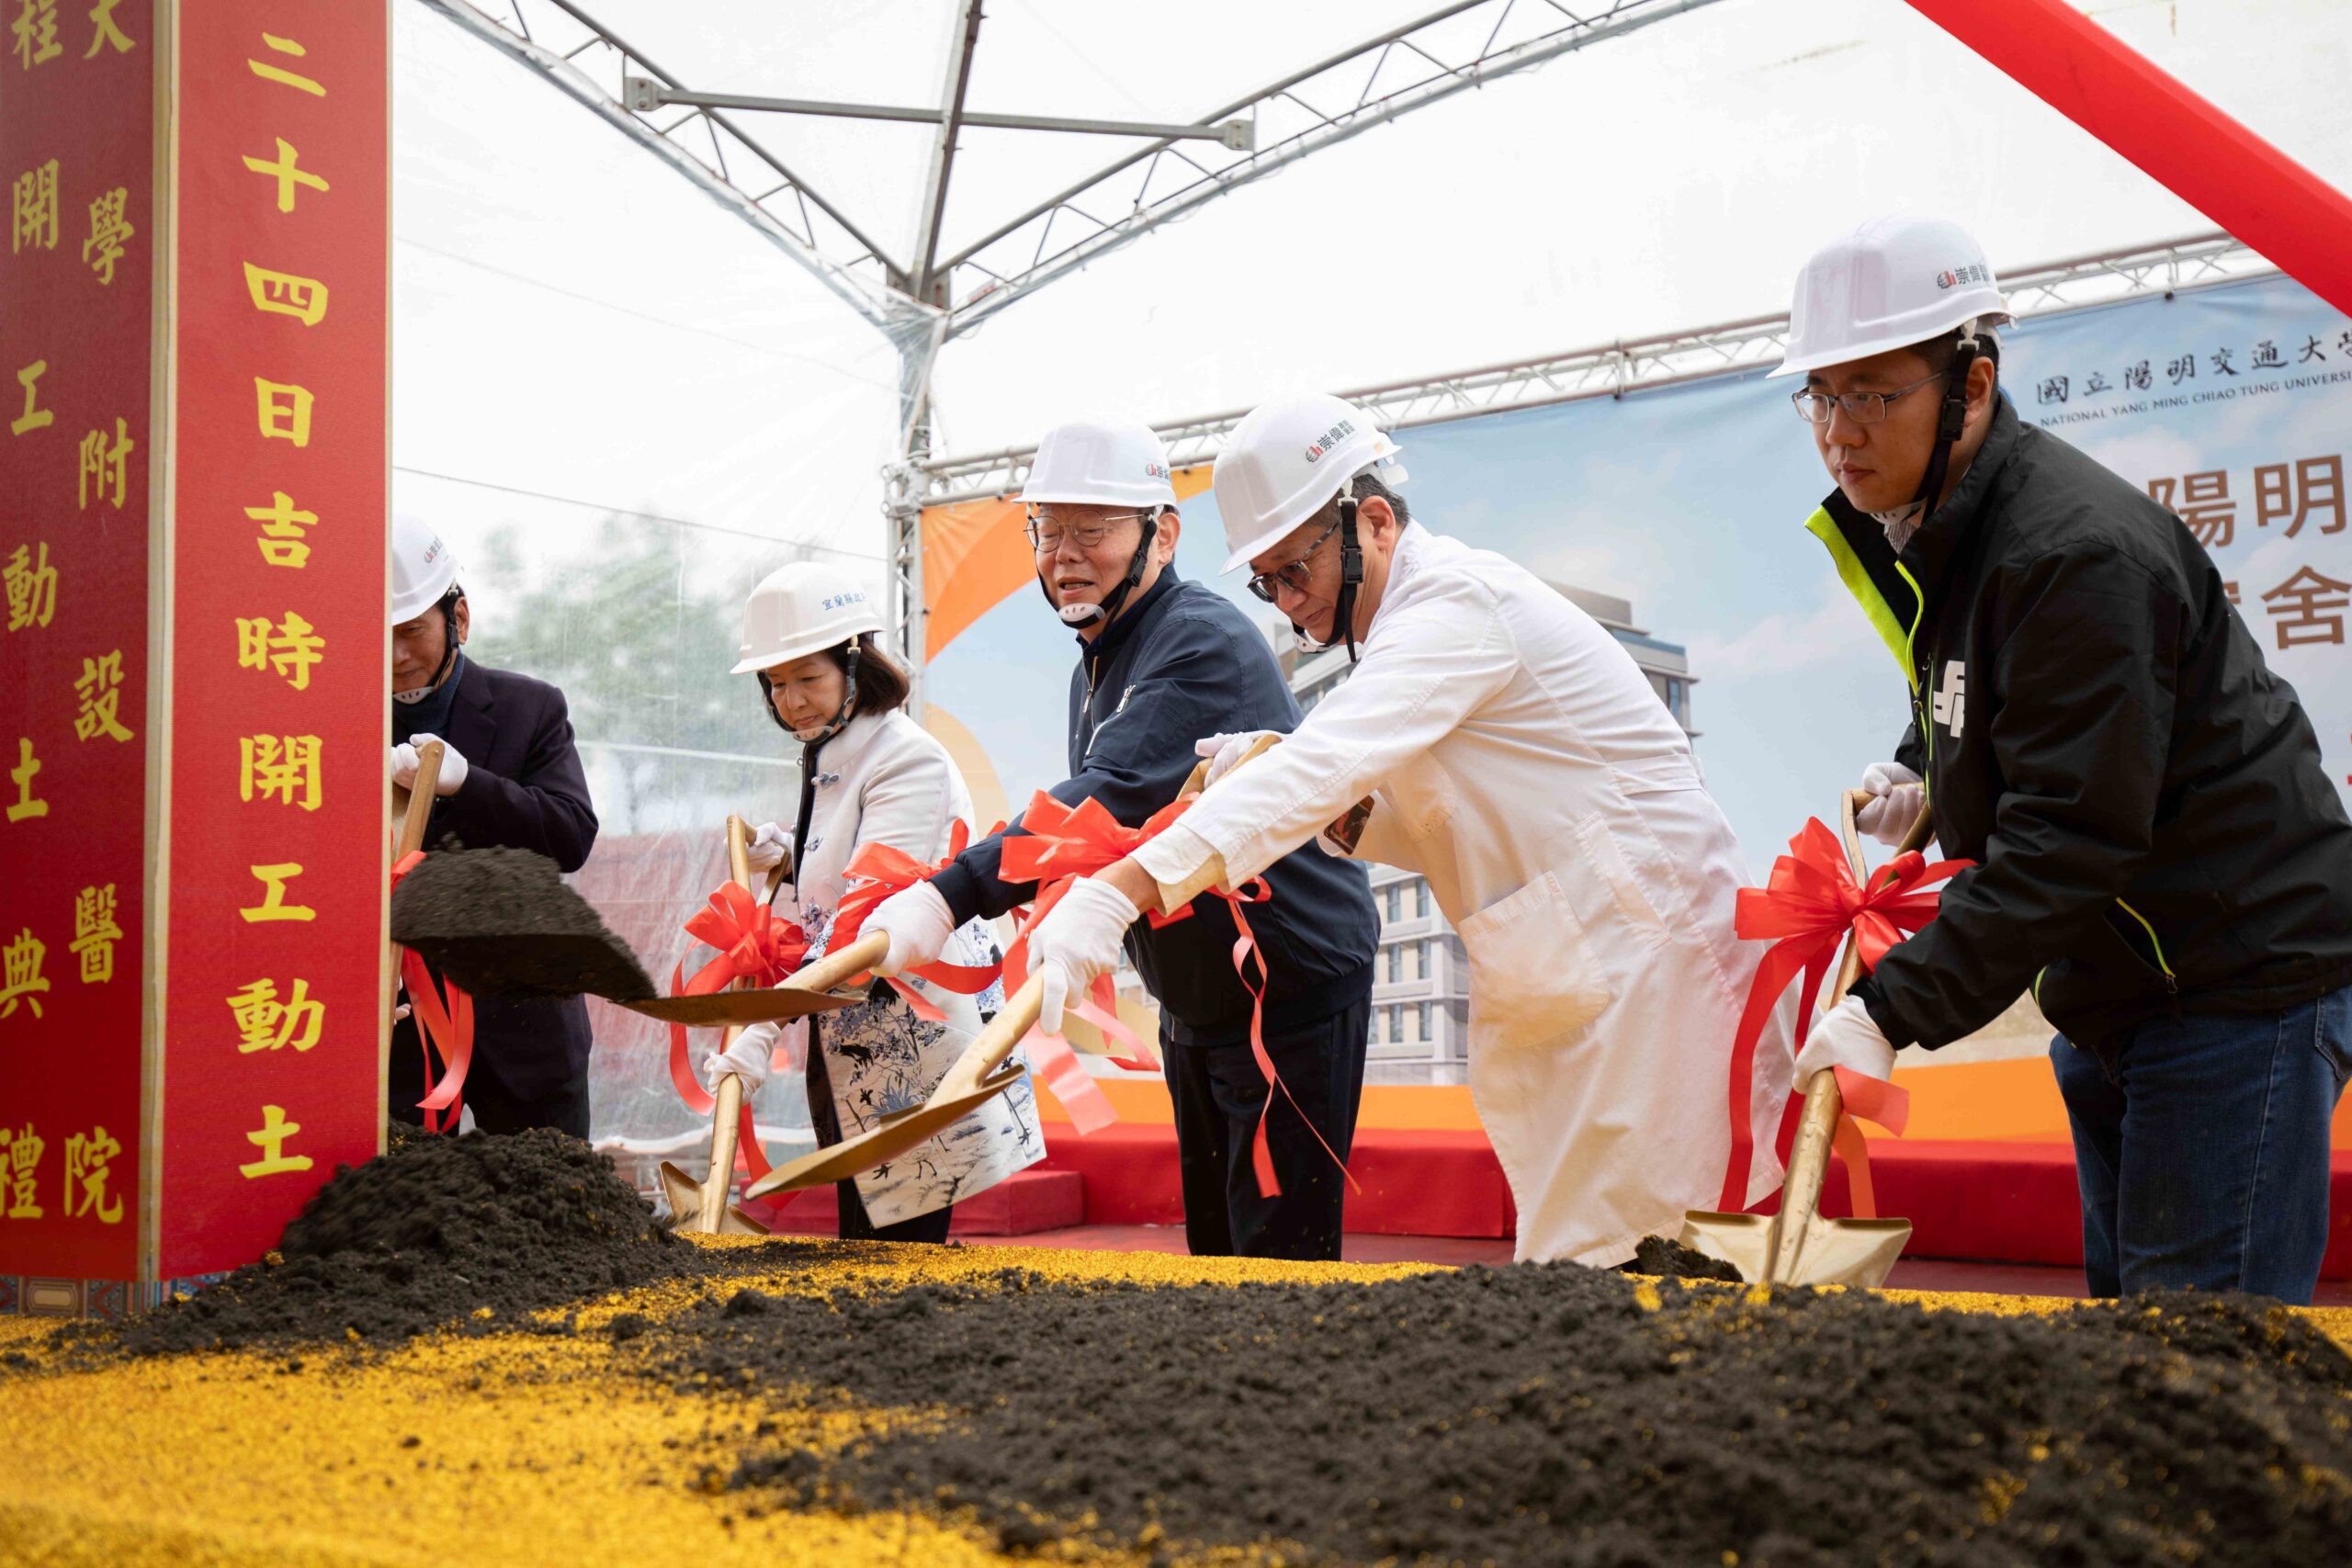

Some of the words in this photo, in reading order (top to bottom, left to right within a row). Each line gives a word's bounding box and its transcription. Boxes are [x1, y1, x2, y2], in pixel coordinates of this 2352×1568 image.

[2041, 409, 2106, 427] NATIONAL
[2111, 401, 2148, 416] YANG
[2154, 396, 2188, 410] MING
[2193, 388, 2236, 404] CHIAO
[2241, 381, 2280, 396] TUNG
[2148, 453, 2347, 549] 陽明
[63, 0, 135, 1224] 大學附設醫院
[226, 32, 330, 1179] 二十四日吉時開工動土
[2222, 565, 2352, 650] 舍
